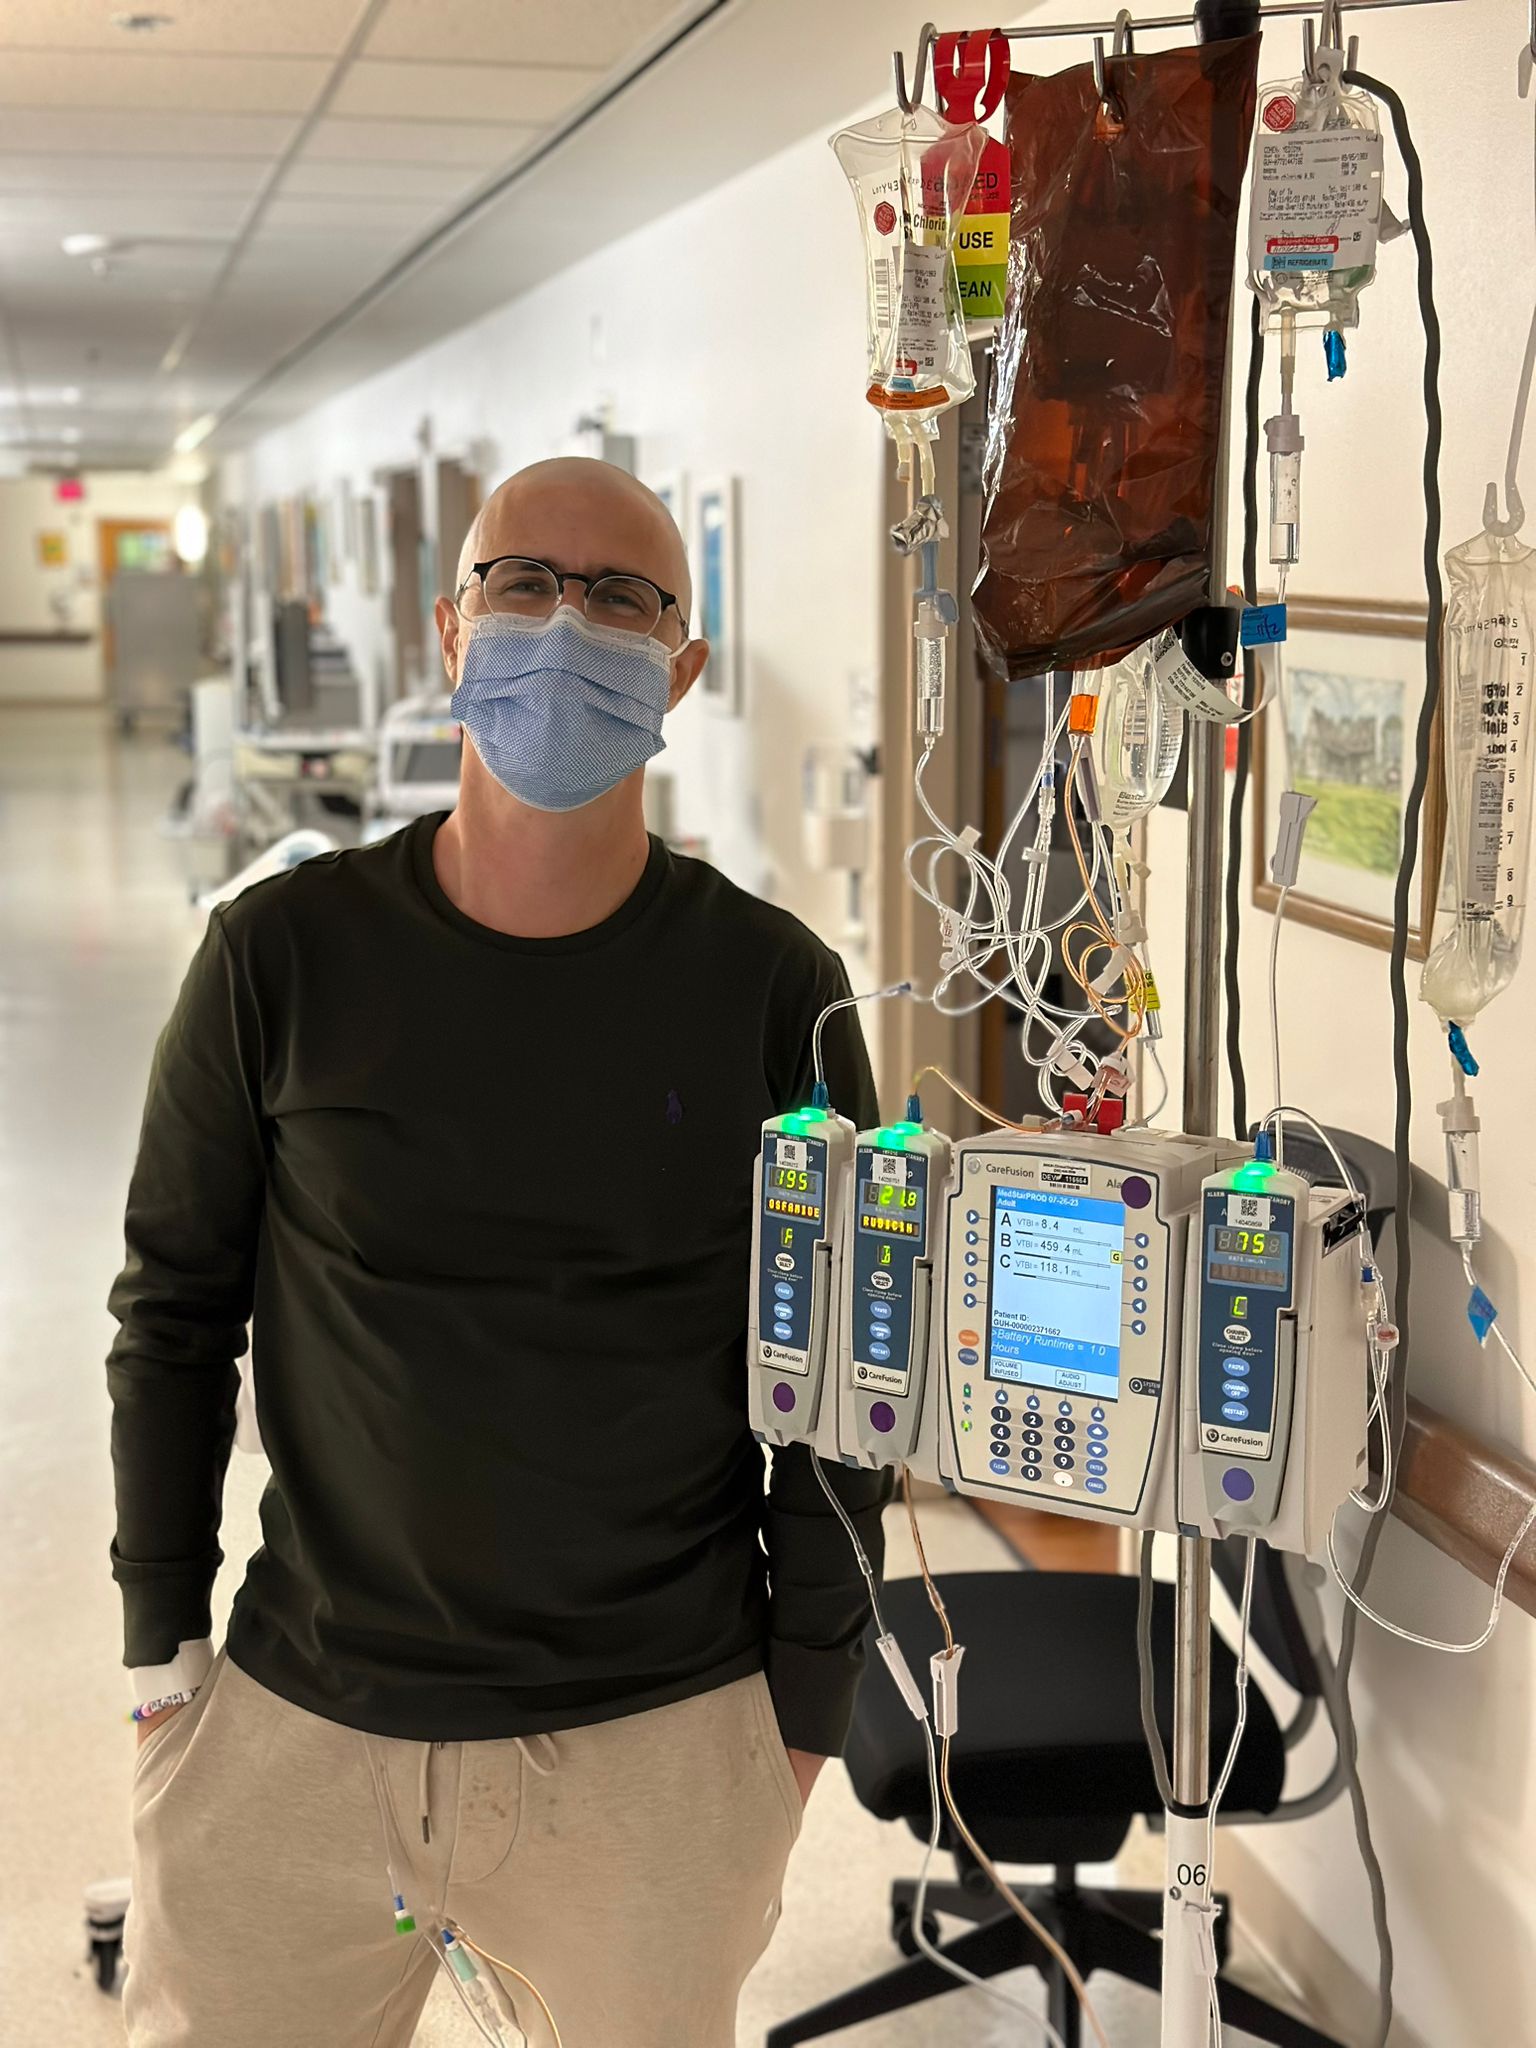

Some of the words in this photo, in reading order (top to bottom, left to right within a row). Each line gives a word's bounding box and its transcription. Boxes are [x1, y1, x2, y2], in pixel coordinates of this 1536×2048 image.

[913, 214, 947, 231] Chlorid
[960, 231, 993, 249] USE
[958, 280, 992, 298] EAN
[986, 1163, 1034, 1179] CareFusion
[779, 1170, 808, 1191] 195
[1106, 1179, 1122, 1189] Ala
[1000, 1212, 1012, 1227] A
[1017, 1218, 1034, 1227] VTBI
[1000, 1233, 1012, 1247] B
[1016, 1239, 1033, 1248] VTBI
[1238, 1231, 1265, 1254] 75
[1000, 1254, 1011, 1268] C
[1015, 1260, 1032, 1269] VTBI
[1233, 1296, 1248, 1315] C
[993, 1309, 1018, 1320] Patient
[1226, 1328, 1249, 1337] CHANNEL
[991, 1341, 1020, 1355] Hours
[1034, 1335, 1074, 1351] Runtime
[773, 1350, 804, 1363] CareFusion
[994, 1360, 1018, 1370] VOLUME
[994, 1368, 1019, 1377] INFUSED
[869, 1371, 903, 1384] CareFusion
[1058, 1379, 1082, 1388] ADJUST
[1061, 1372, 1080, 1380] AUDIO
[999, 1409, 1003, 1419] 1
[1029, 1415, 1036, 1425] 2
[1061, 1421, 1068, 1431] 3
[997, 1427, 1004, 1437] 4
[1029, 1433, 1036, 1443] 5
[1061, 1439, 1068, 1449] 6
[1220, 1433, 1263, 1447] CareFusion
[997, 1444, 1004, 1454] 7
[1028, 1451, 1035, 1460] 8
[1060, 1457, 1067, 1466] 9
[1028, 1468, 1035, 1478] 0
[1177, 1864, 1207, 1886] 06
